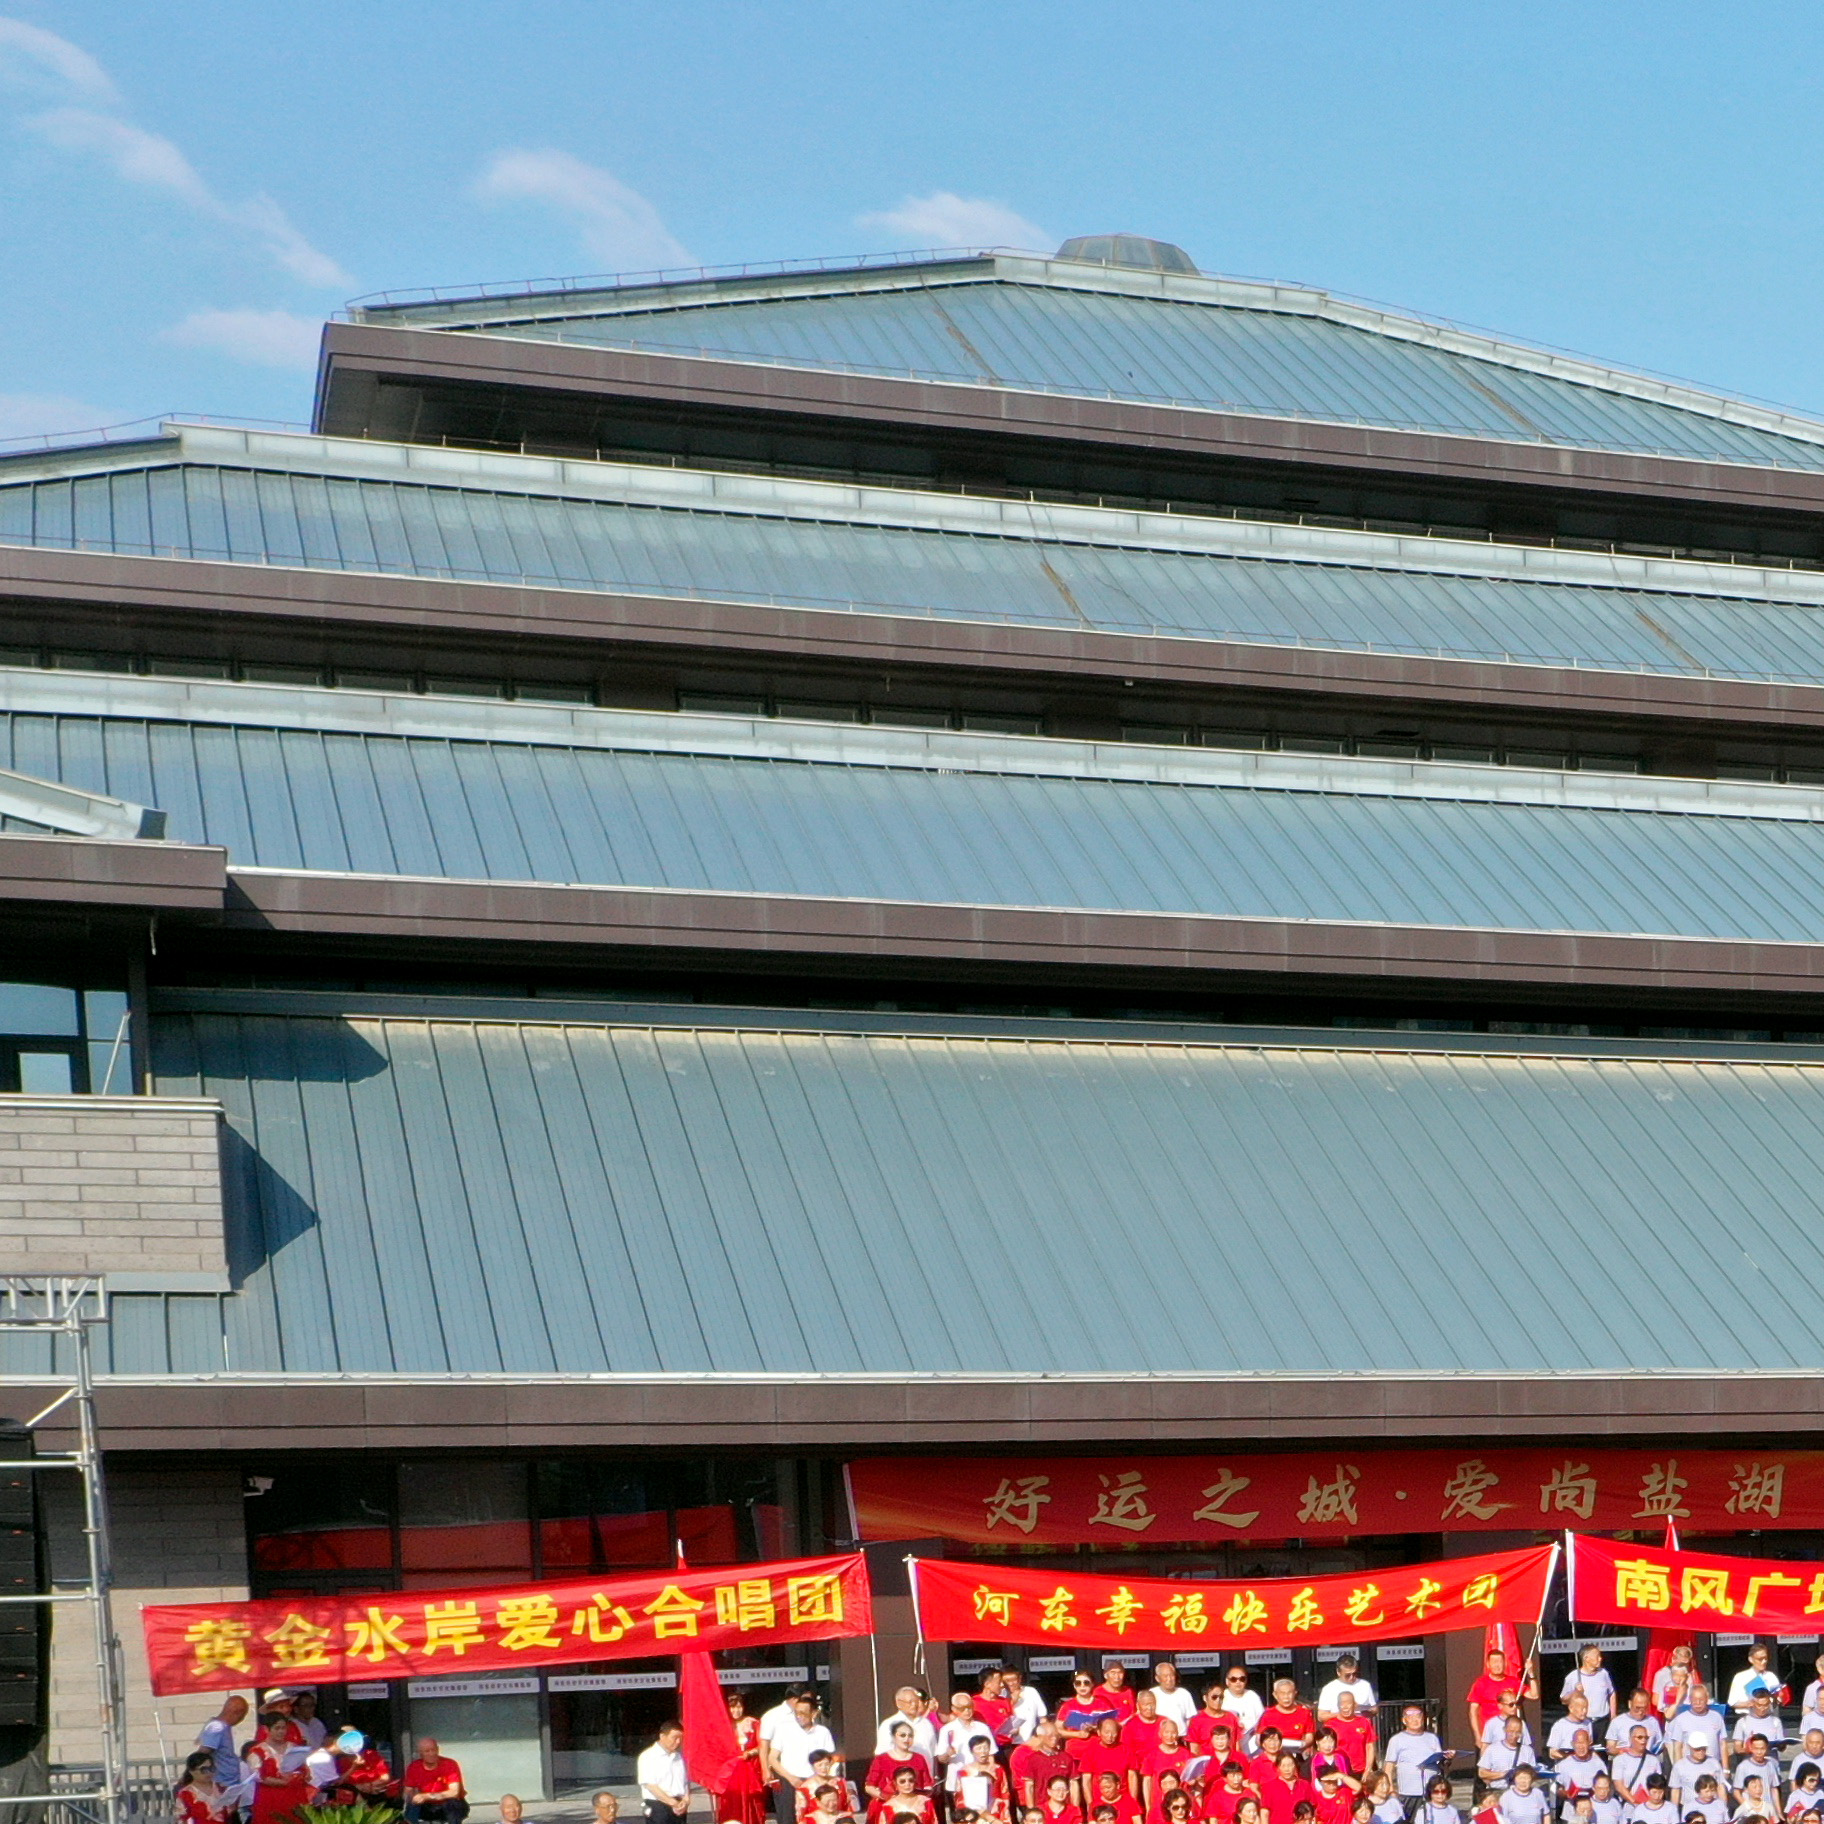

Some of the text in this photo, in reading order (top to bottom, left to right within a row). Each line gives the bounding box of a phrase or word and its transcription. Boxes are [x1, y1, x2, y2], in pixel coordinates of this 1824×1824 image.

[184, 1573, 846, 1677] 黄金水岸爱心合唱团
[973, 1572, 1501, 1636] 河东幸福快乐艺术团
